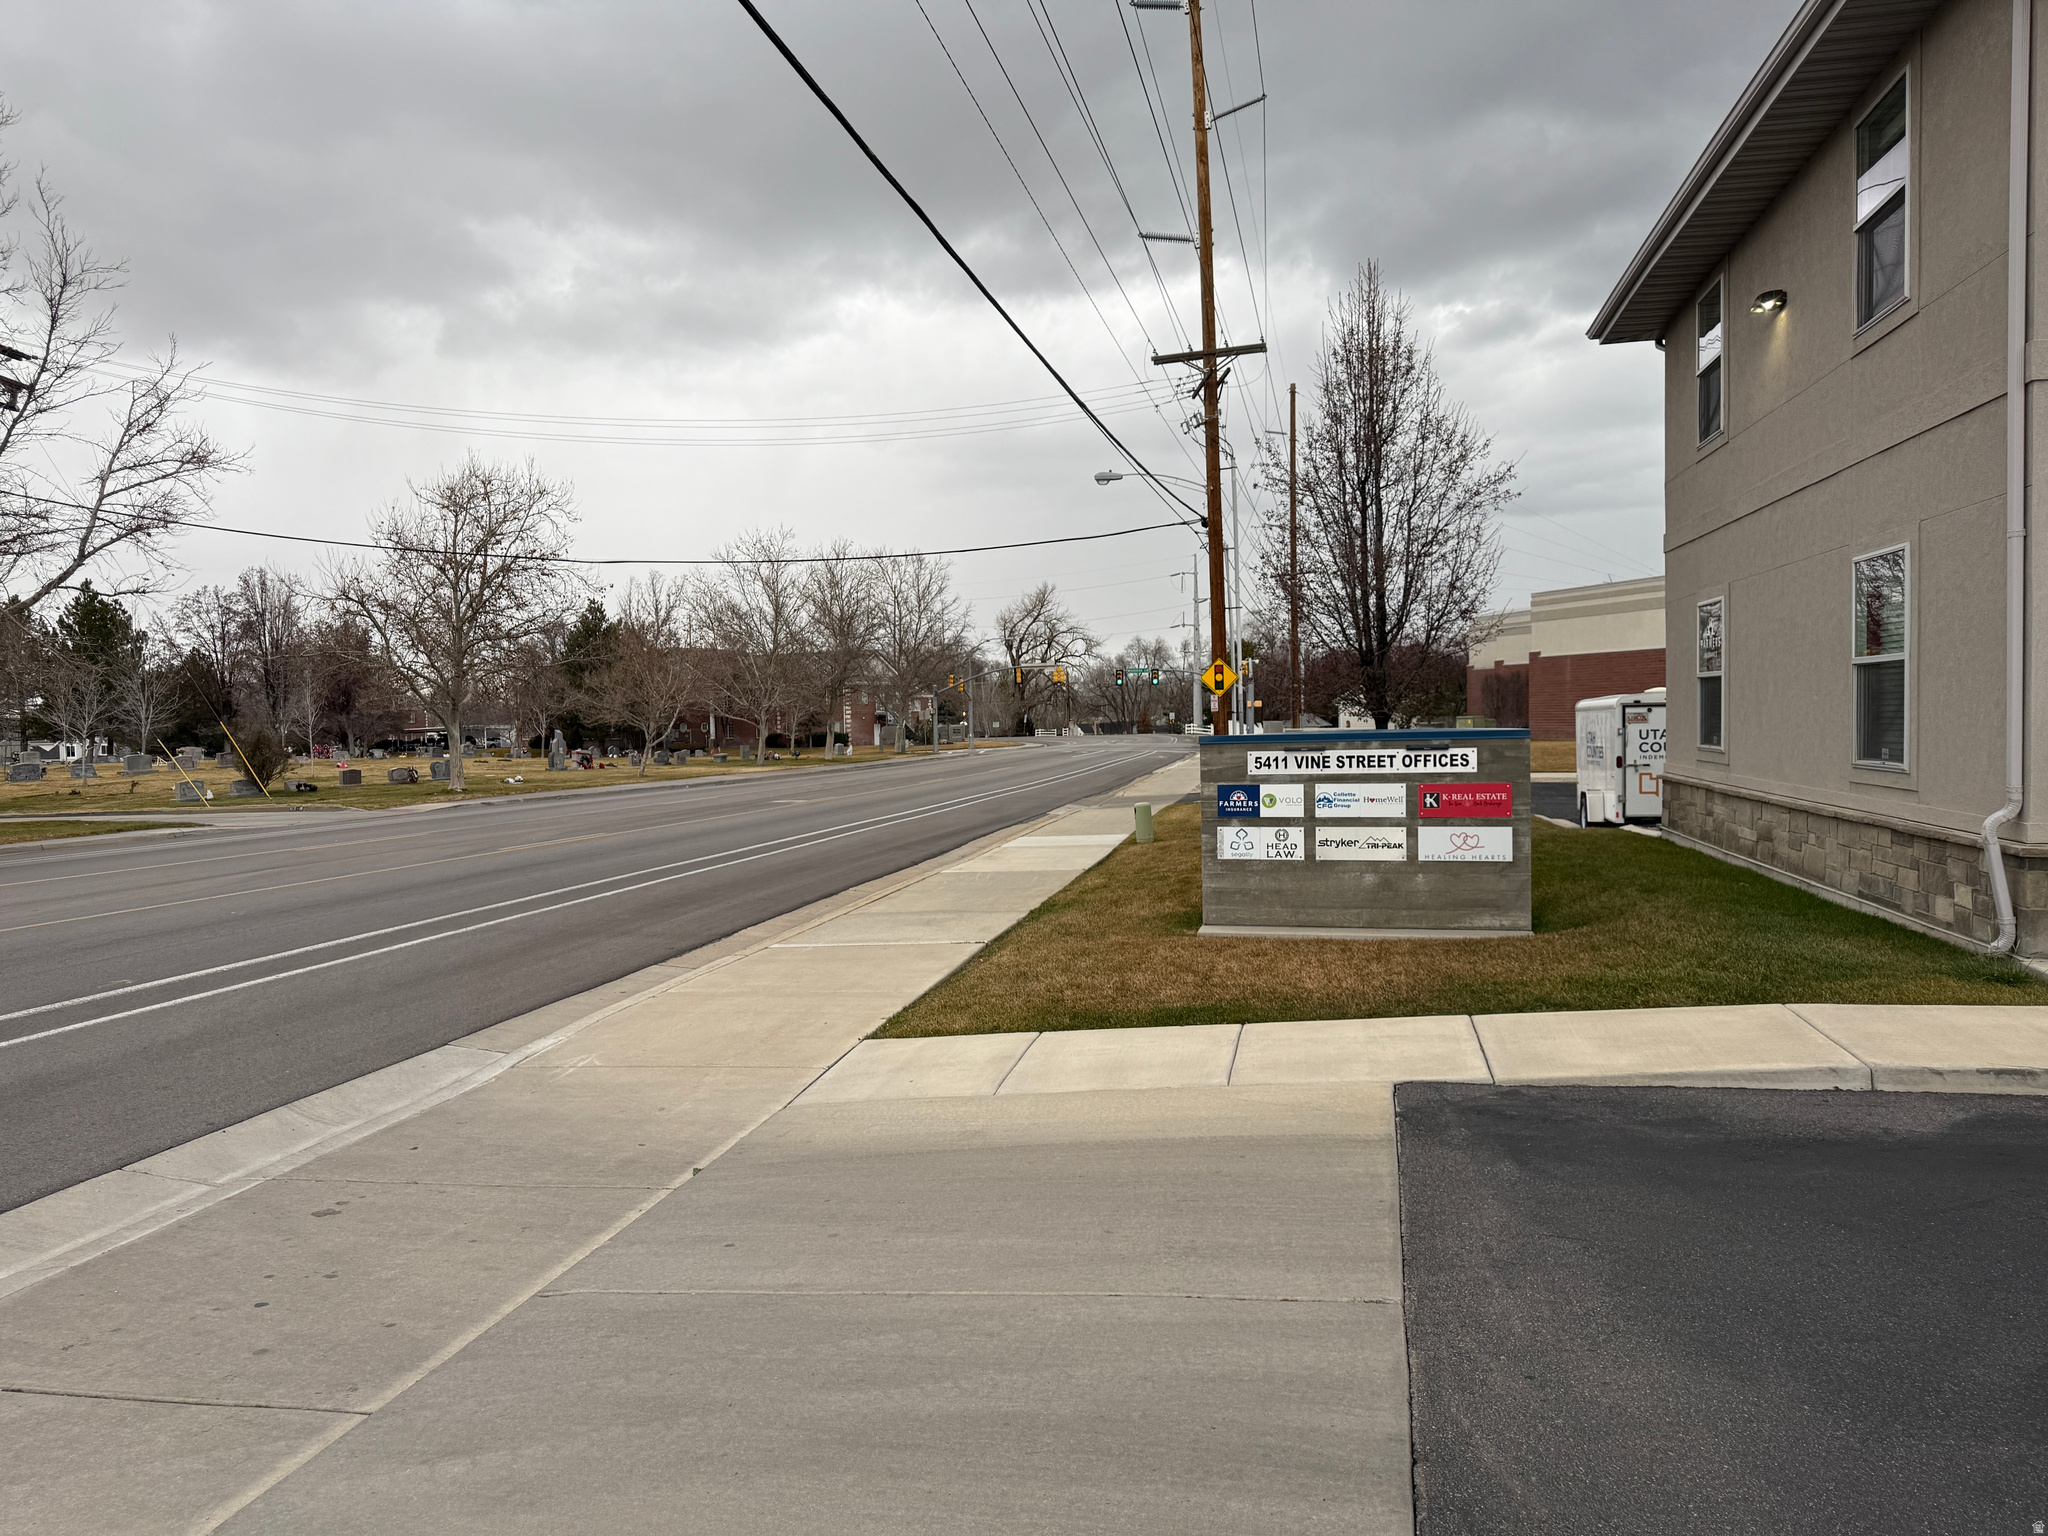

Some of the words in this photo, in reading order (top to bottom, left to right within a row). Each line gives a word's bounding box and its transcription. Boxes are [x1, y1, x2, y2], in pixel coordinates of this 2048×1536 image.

[1254, 756, 1288, 770] 5411
[1294, 755, 1331, 769] VINE
[1336, 754, 1397, 769] STREET
[1401, 753, 1470, 768] OFFICES
[1476, 792, 1507, 800] ESTATE
[1317, 838, 1360, 849] stryker
[1267, 850, 1295, 858] LAW
